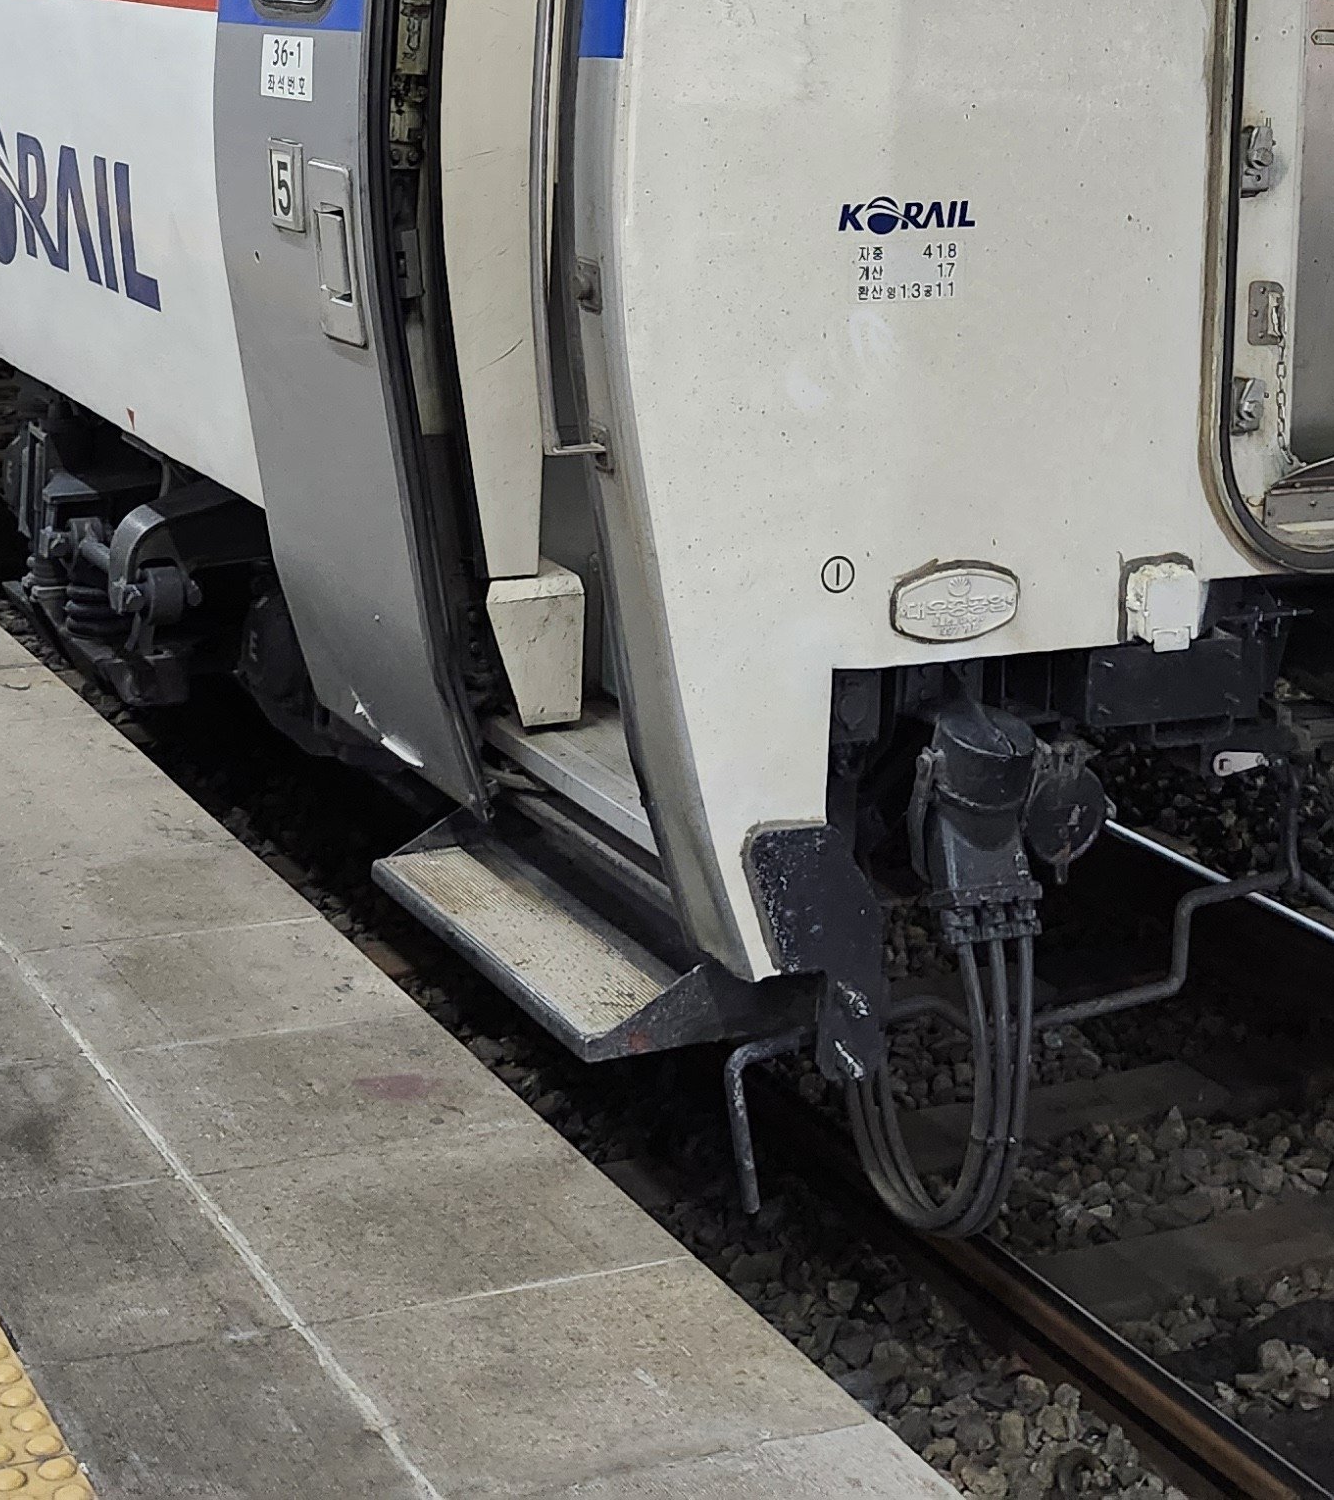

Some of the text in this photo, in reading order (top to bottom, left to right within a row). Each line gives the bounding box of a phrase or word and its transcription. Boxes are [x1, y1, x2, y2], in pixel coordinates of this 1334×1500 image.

[271, 38, 303, 69] 36-1
[267, 73, 306, 96] 좌석번호
[276, 160, 292, 216] 5
[838, 196, 976, 235] KORAIL
[858, 245, 884, 261] 자중
[857, 284, 884, 301] 환산
